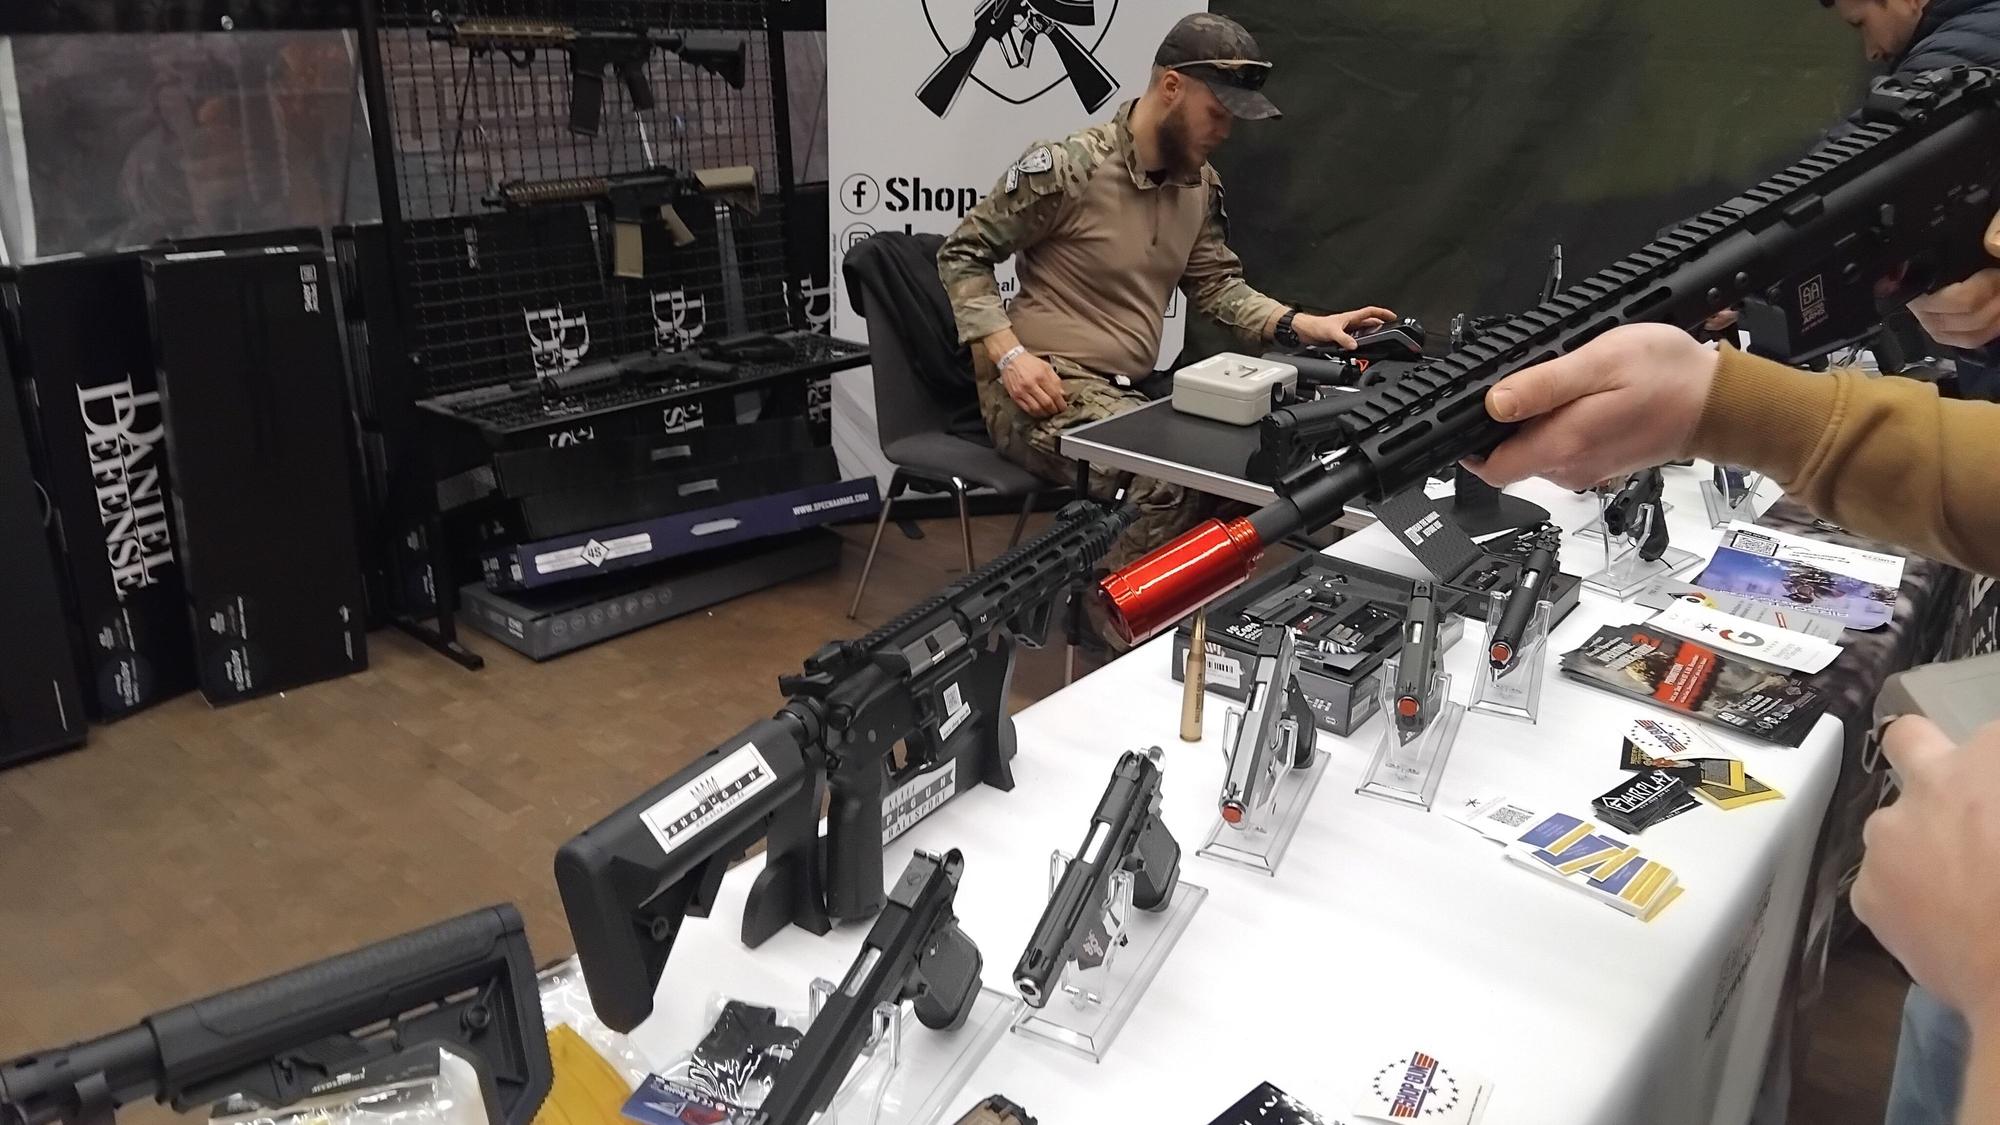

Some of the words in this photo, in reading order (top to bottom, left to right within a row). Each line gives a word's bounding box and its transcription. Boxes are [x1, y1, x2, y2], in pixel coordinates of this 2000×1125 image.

[76, 374, 132, 600] DEFENSE
[114, 389, 174, 589] DANIEL
[670, 804, 707, 834] SHOP
[721, 771, 757, 798] GUN
[1610, 769, 1673, 811] FAIRPLAY
[1396, 1083, 1421, 1107] SHOP
[1404, 1066, 1430, 1084] GUN
